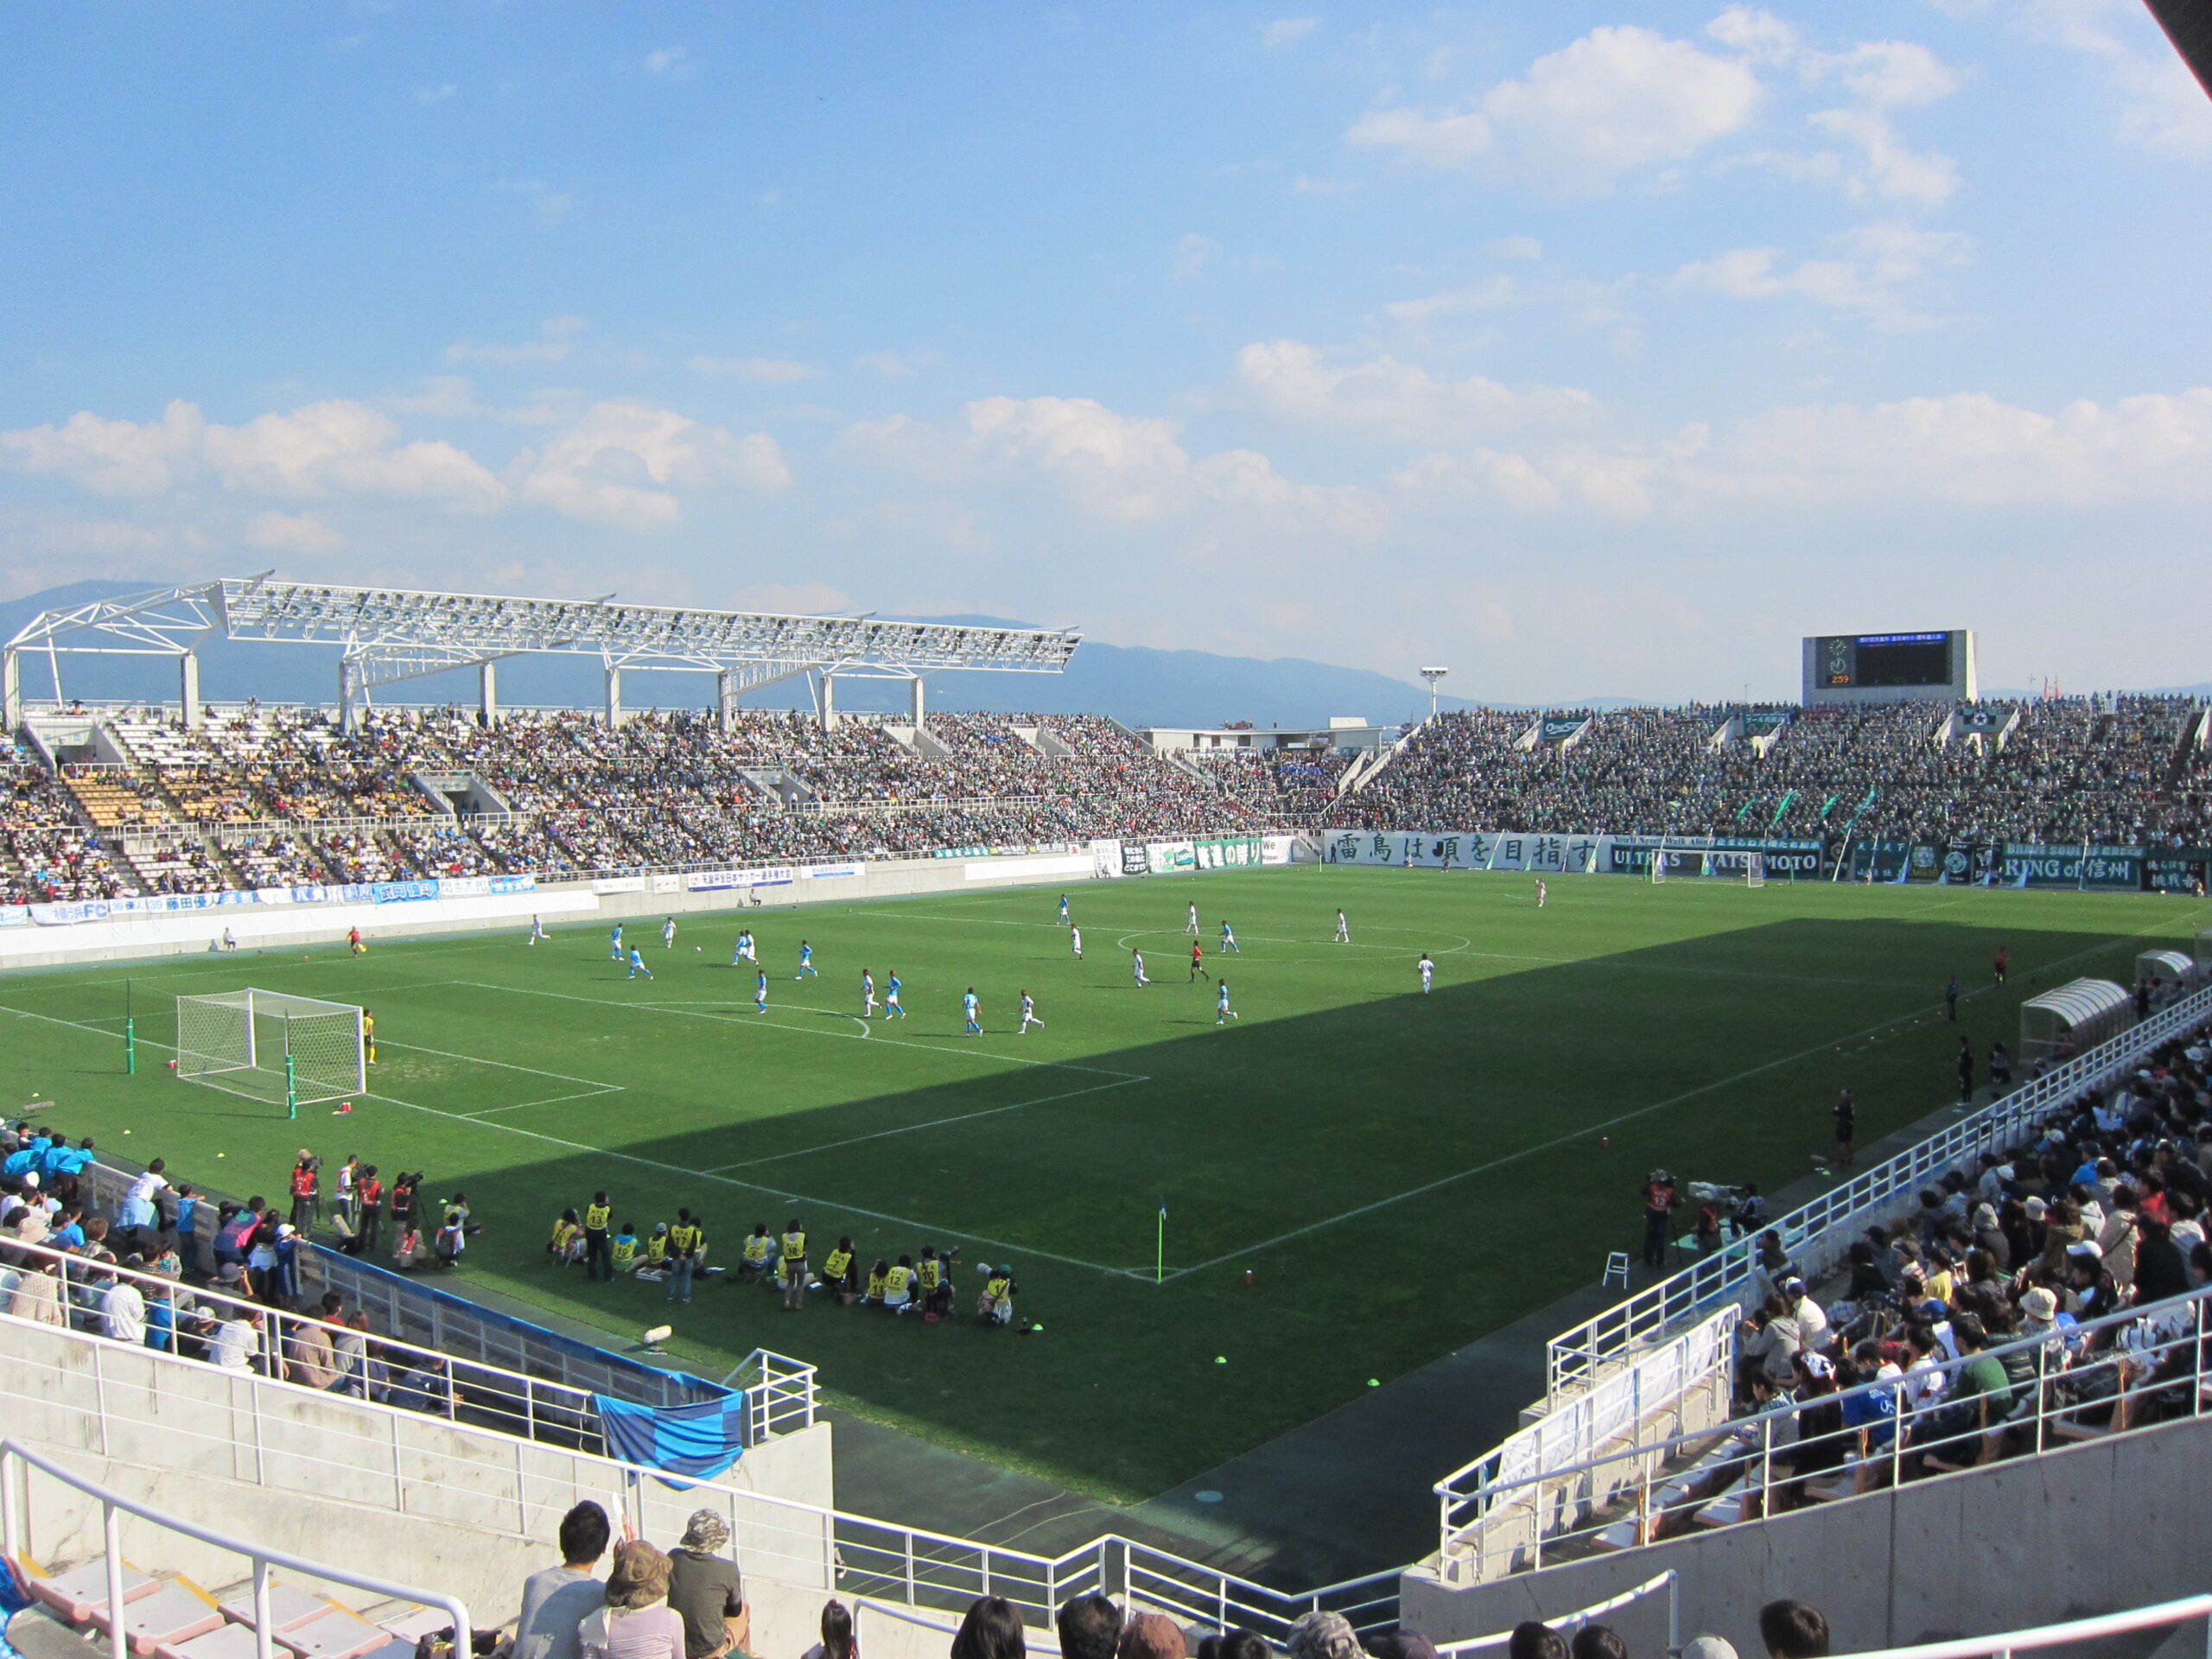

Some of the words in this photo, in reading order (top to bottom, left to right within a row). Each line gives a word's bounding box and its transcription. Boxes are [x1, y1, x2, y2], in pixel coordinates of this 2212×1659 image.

[1262, 840, 1275, 850] We
[2005, 858, 2060, 877] KING
[2063, 860, 2083, 878] of
[2085, 858, 2130, 880] 信州
[591, 1216, 602, 1224] 13
[676, 1236, 686, 1245] 17
[889, 1276, 901, 1286] 12
[995, 1284, 1000, 1294] 1
